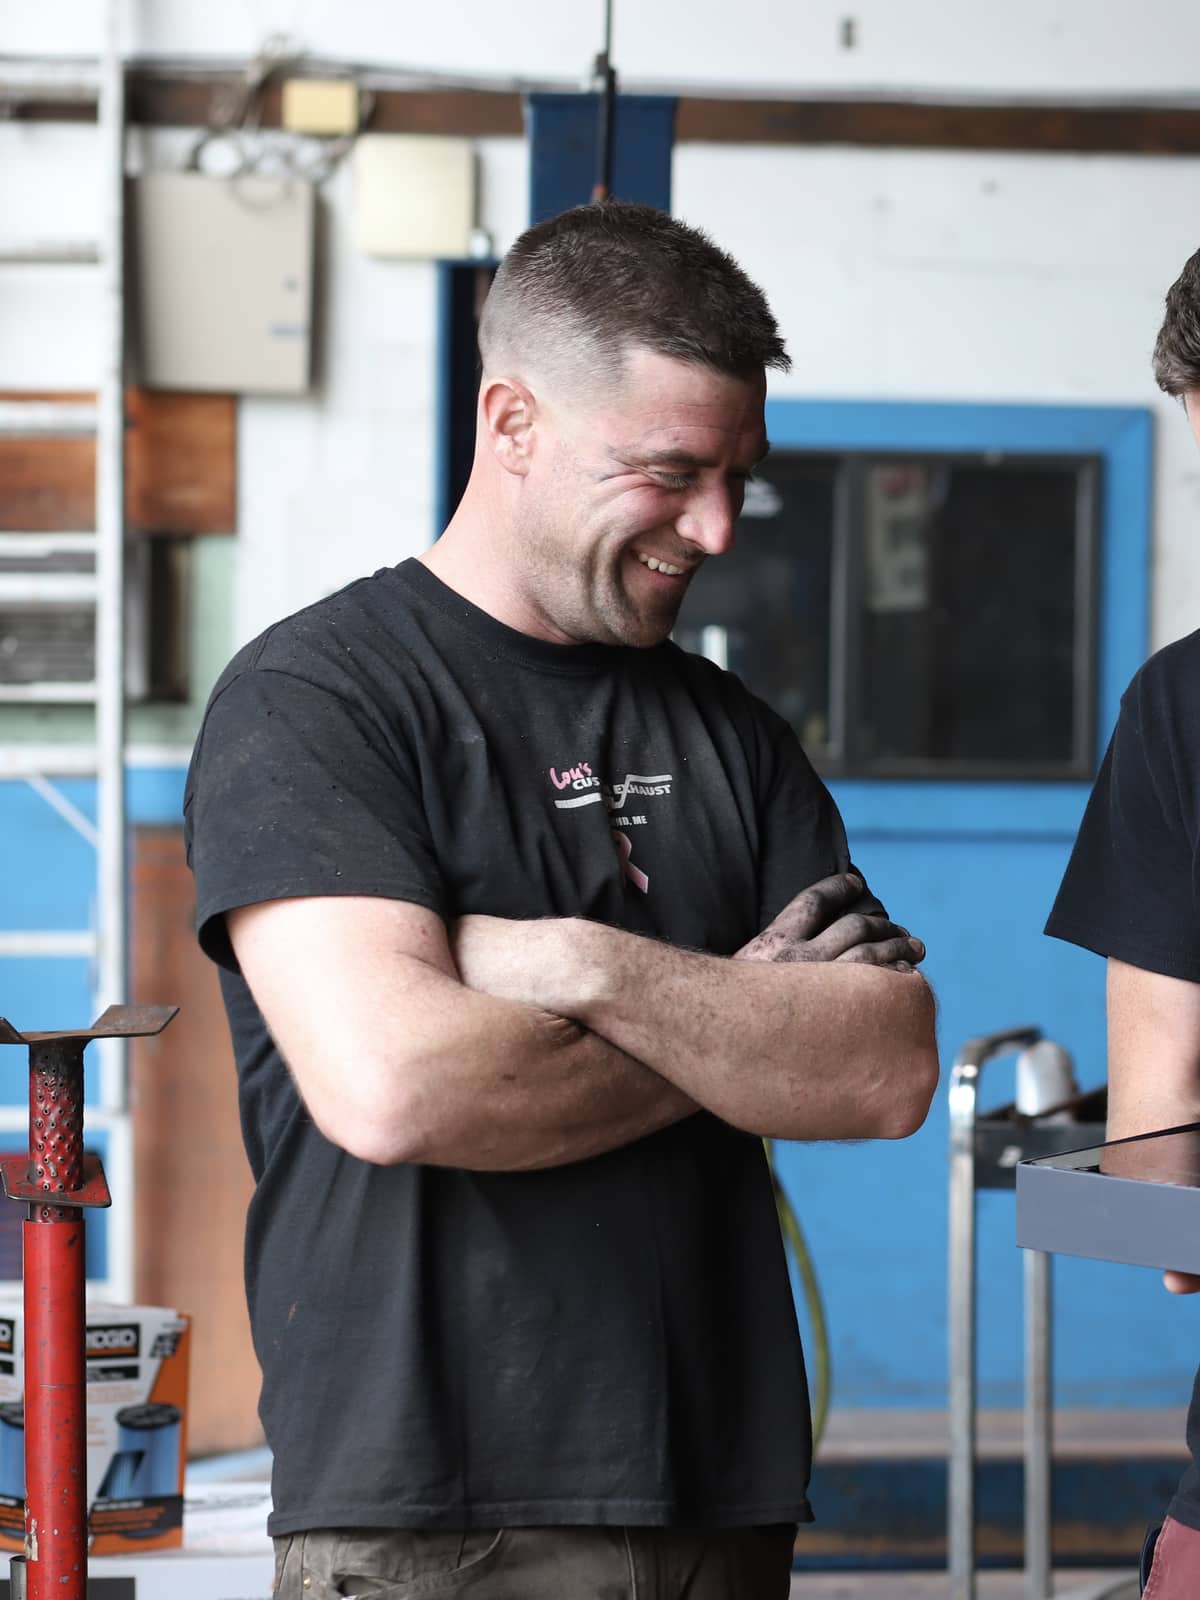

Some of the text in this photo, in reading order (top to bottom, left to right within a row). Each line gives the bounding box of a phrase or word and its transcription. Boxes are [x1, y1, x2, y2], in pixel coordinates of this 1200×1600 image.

[550, 762, 592, 790] Lou's
[572, 777, 600, 790] CUS
[632, 815, 648, 824] ME
